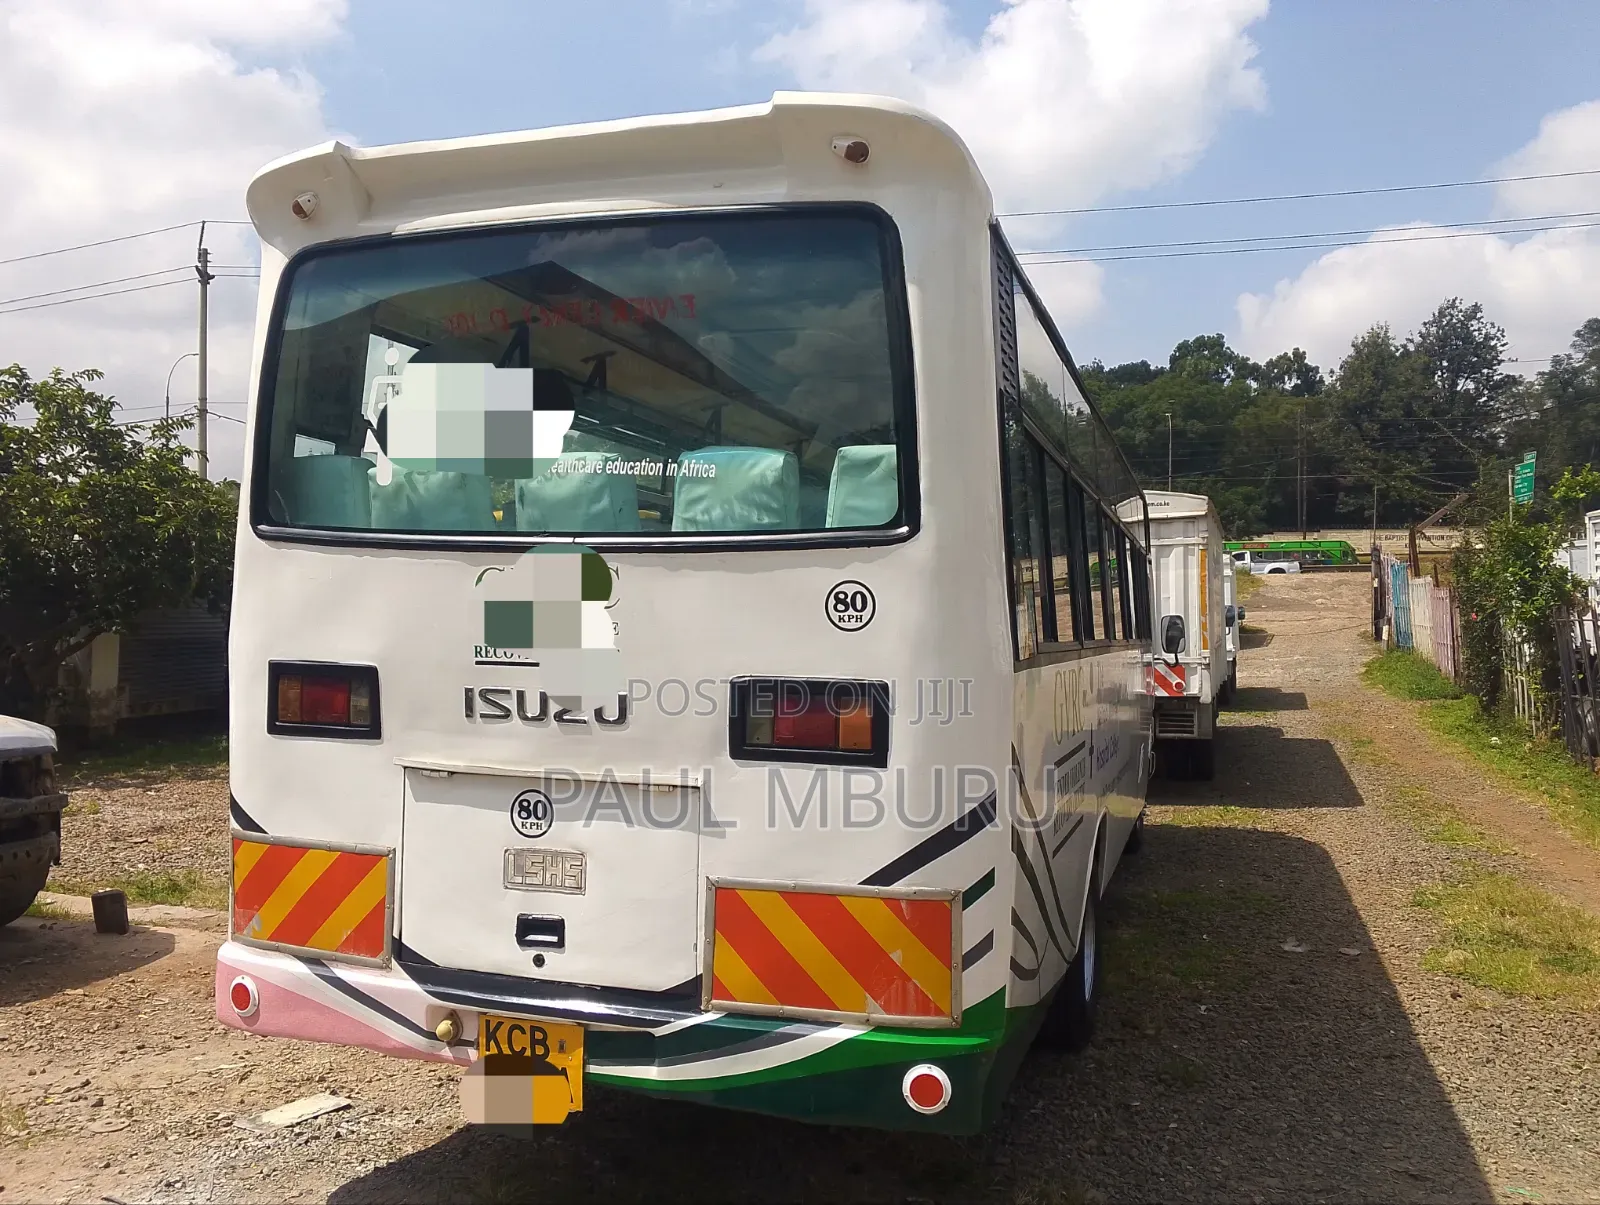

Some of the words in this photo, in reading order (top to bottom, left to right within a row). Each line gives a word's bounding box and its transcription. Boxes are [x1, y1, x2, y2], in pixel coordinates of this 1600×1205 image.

[548, 458, 602, 474] ealthcare
[605, 456, 664, 476] education
[666, 458, 678, 477] in
[680, 459, 716, 478] Africa
[832, 590, 868, 613] 80
[837, 614, 864, 624] KPH
[517, 798, 548, 821] 80
[521, 821, 543, 831] KPH
[484, 1019, 550, 1061] KCB
